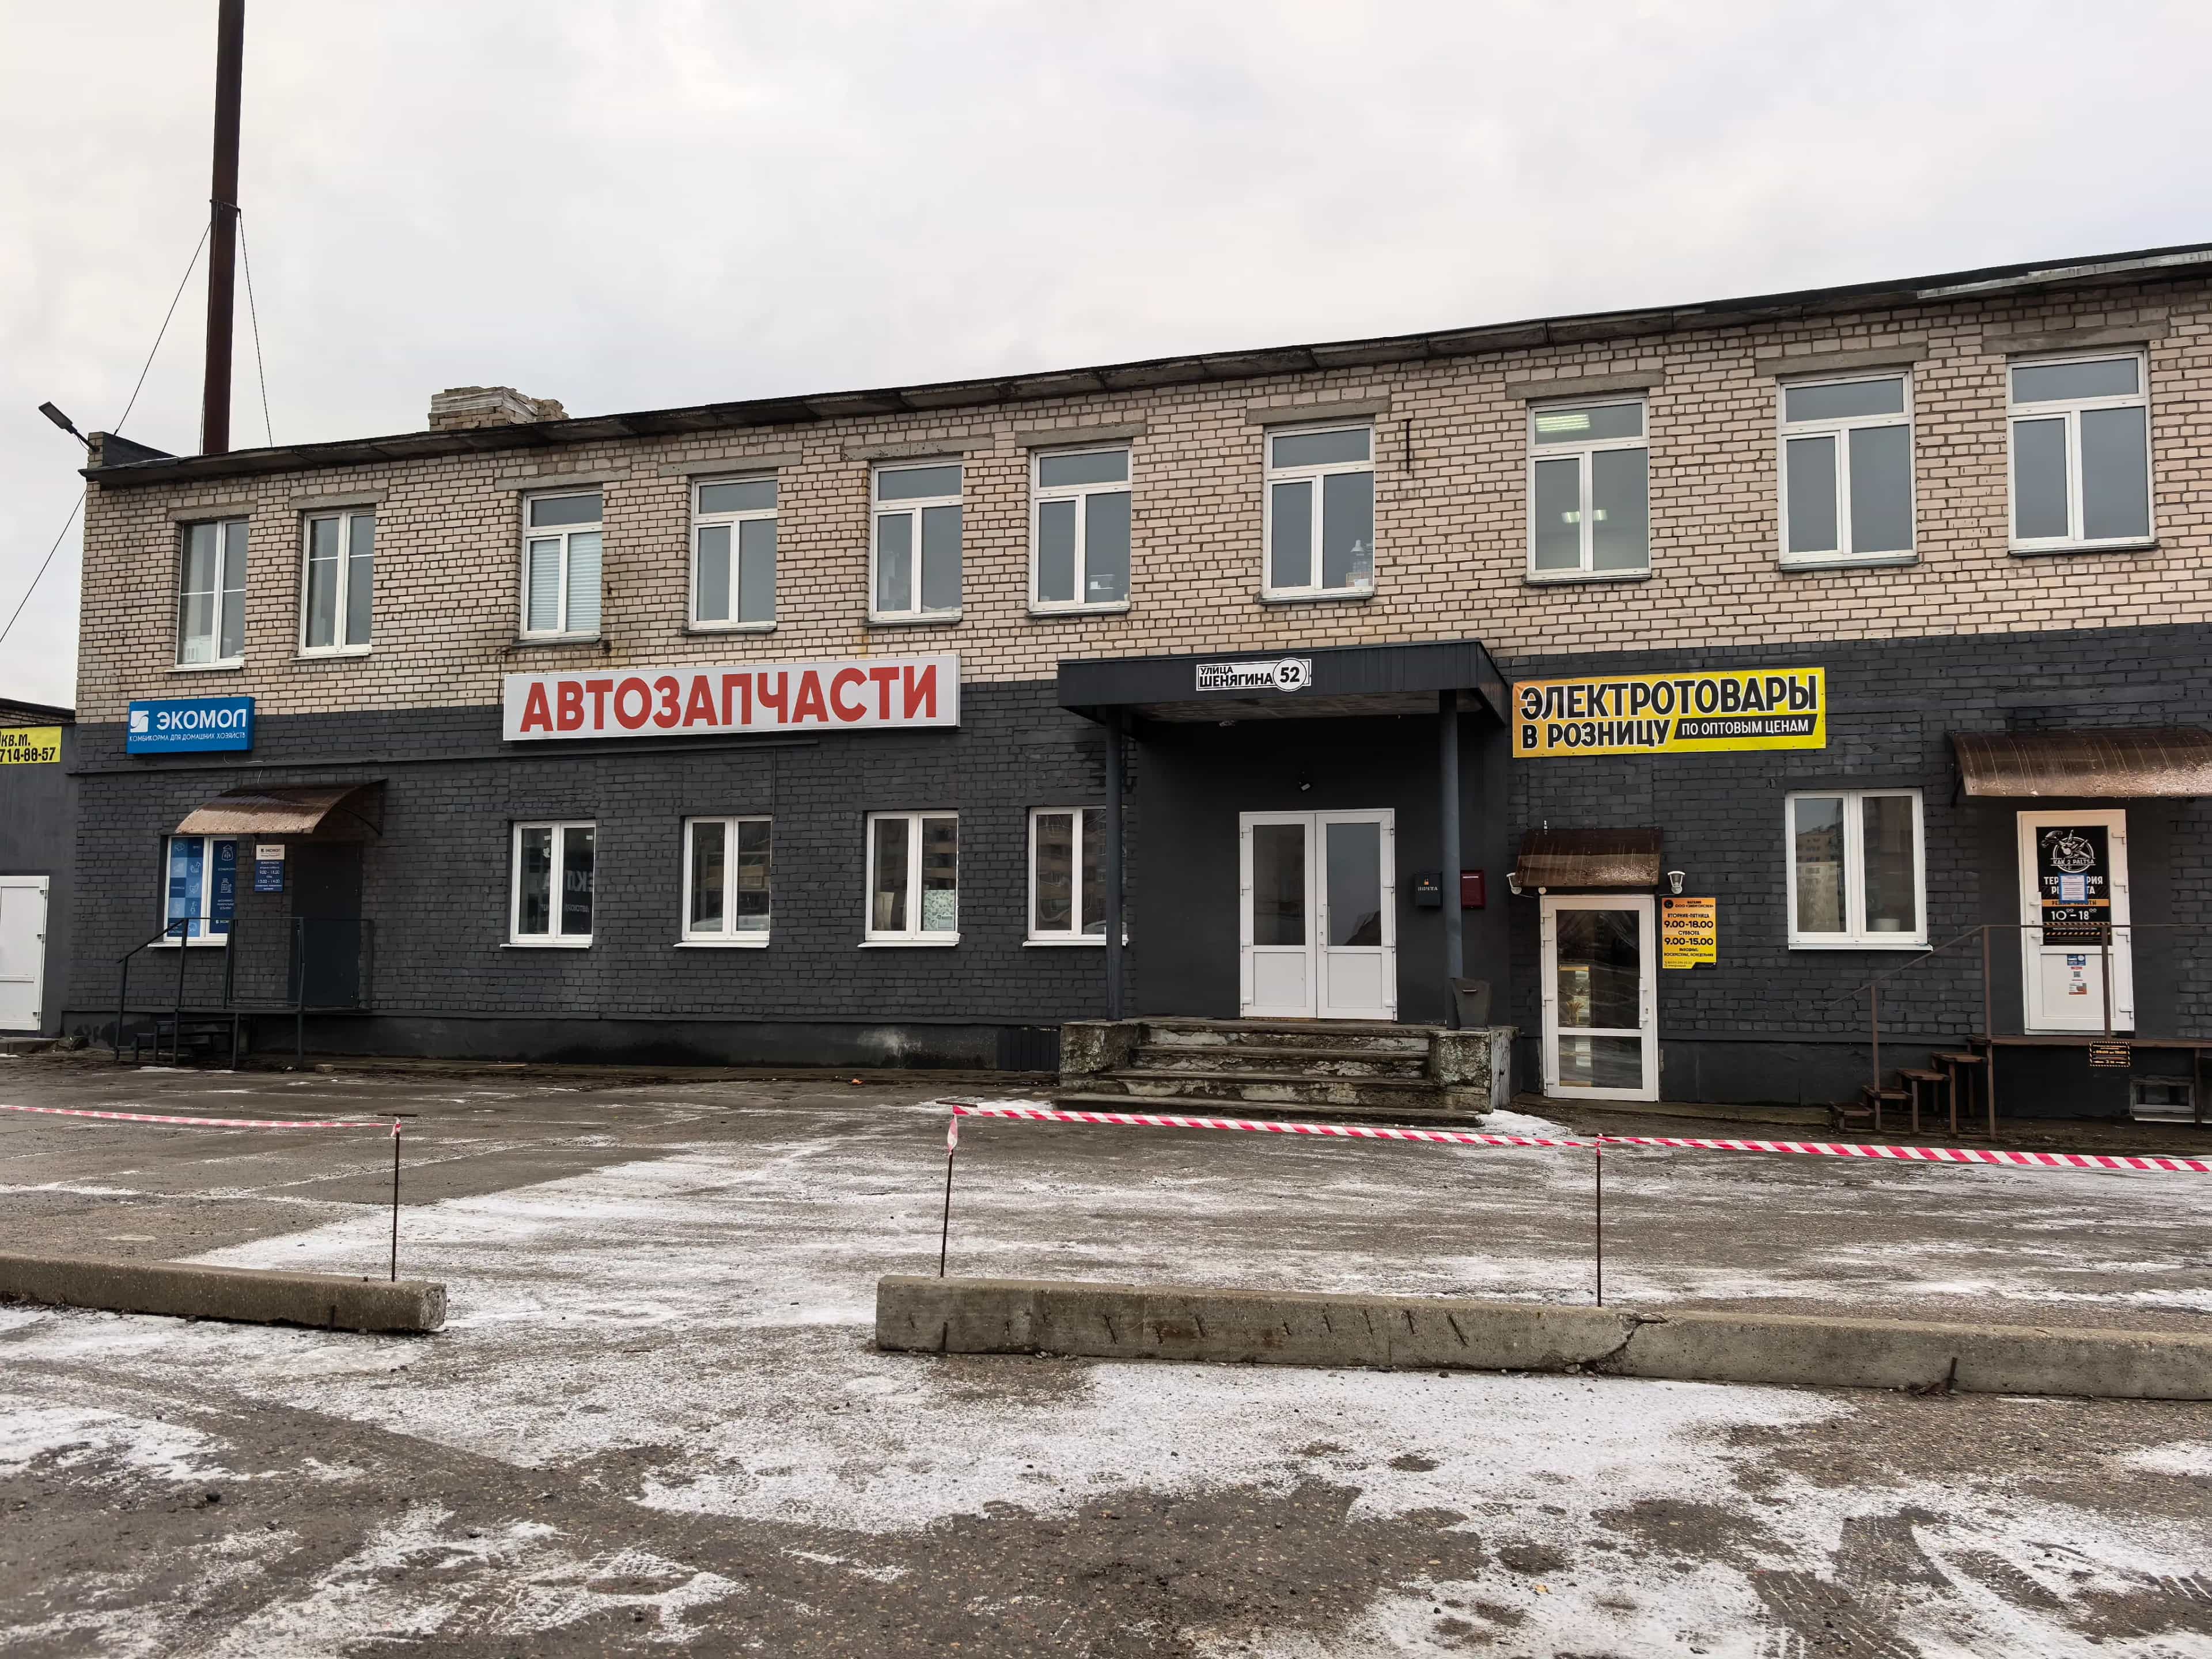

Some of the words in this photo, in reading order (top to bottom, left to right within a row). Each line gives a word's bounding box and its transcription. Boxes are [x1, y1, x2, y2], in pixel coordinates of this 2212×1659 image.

[1200, 666, 1233, 675] УЛИЦА
[1279, 666, 1300, 683] 52
[1199, 673, 1273, 687] ШЕНЯГИНА
[520, 665, 937, 733] АВТОЗАПЧАСТИ
[1520, 675, 1818, 720] ЭЛЕКТРОТОВАРЫ
[156, 709, 247, 730] ЭКОМОЛ
[1681, 722, 1697, 736] ПО
[1702, 720, 1763, 735] ОПТОВЫМ
[1766, 718, 1809, 734] ЦЕНАМ
[129, 734, 169, 743] КОМБИКОРМА
[171, 733, 181, 741] ДЛЯ
[182, 733, 215, 741] ДОМАШНИХ
[217, 731, 245, 739] ХОЗЯЙСТВ
[1522, 724, 1538, 749] В
[1548, 719, 1671, 748] РОЗНИЦУ
[2044, 876, 2103, 885] ТЕРРИЯ
